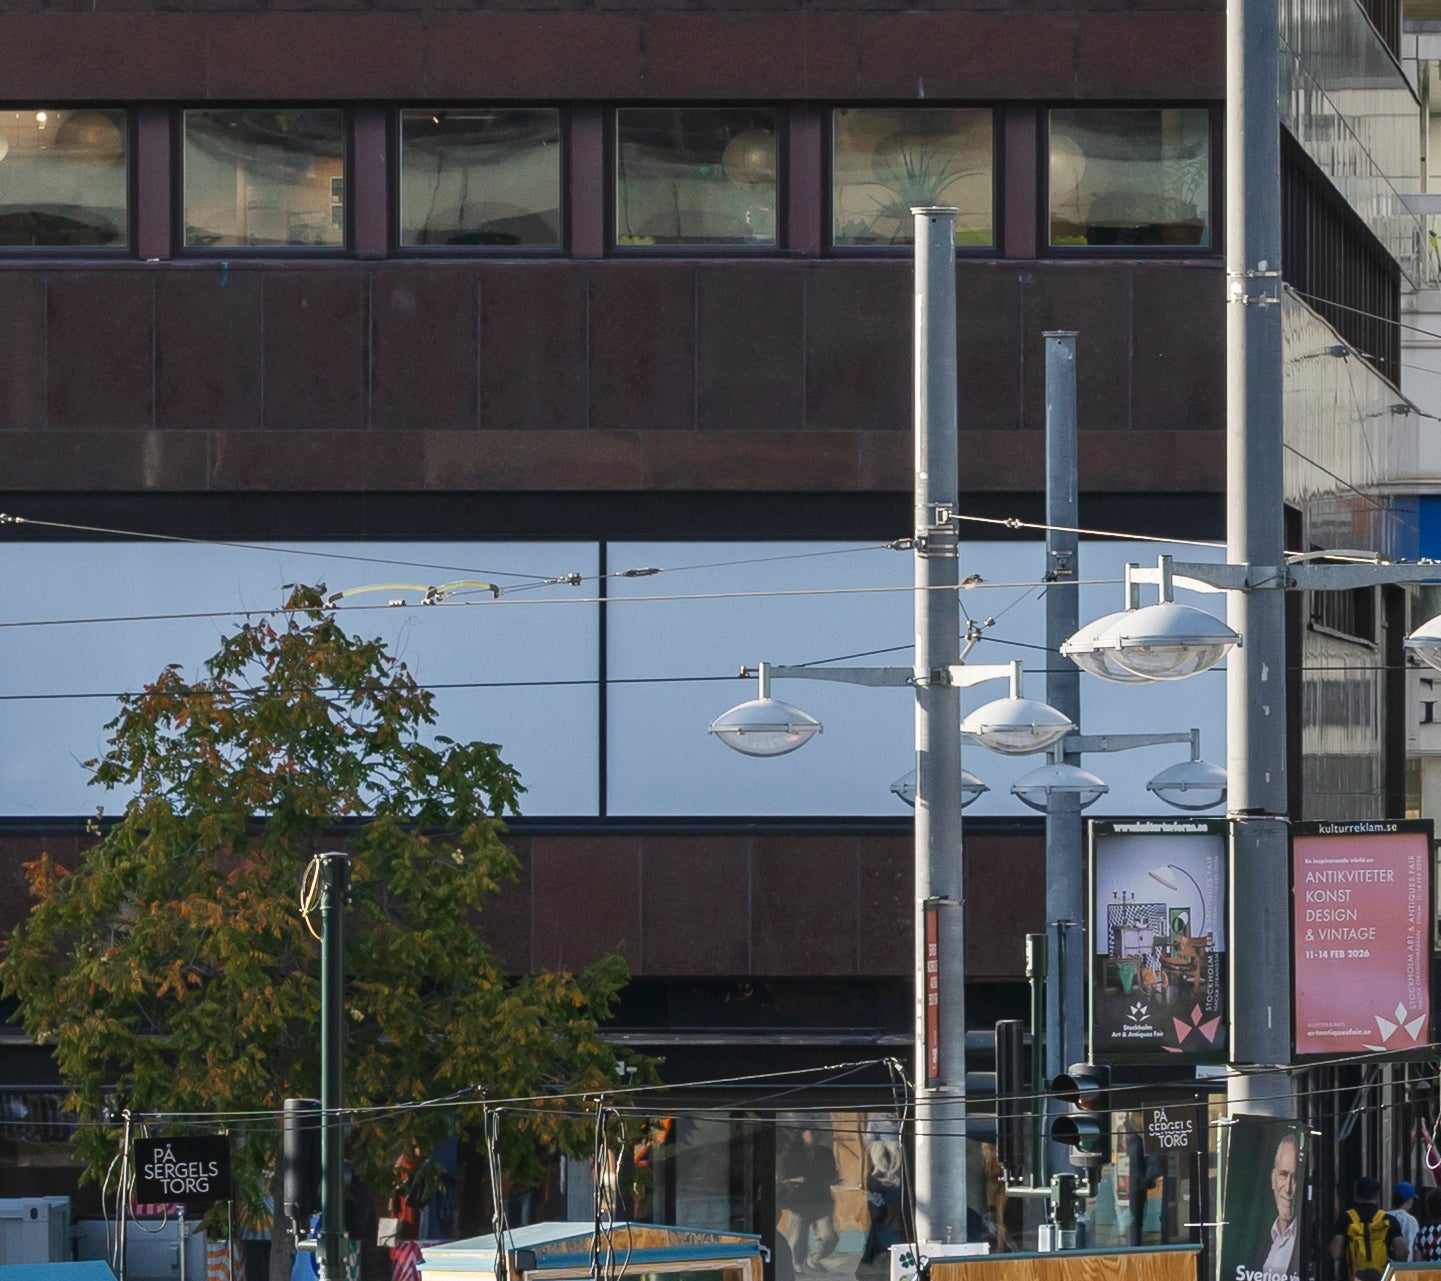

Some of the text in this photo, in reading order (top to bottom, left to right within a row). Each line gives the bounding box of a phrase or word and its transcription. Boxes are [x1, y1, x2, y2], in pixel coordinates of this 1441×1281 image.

[1318, 823, 1398, 834] kulturreklam.se
[1305, 869, 1395, 884] ANTIKVITETER
[1305, 889, 1352, 903] KONST
[1407, 878, 1415, 923] ANTIQUES
[1305, 908, 1358, 922] DESIGN
[1305, 927, 1377, 941] & VINTAGE
[1305, 949, 1371, 960] 11-14 FEB 2026
[1407, 955, 1417, 1009] STOCKHOLM
[1153, 1107, 1168, 1122] PÅ
[1159, 1134, 1188, 1148] TORG
[144, 1143, 219, 1195] PÅ SERGELS TORG
